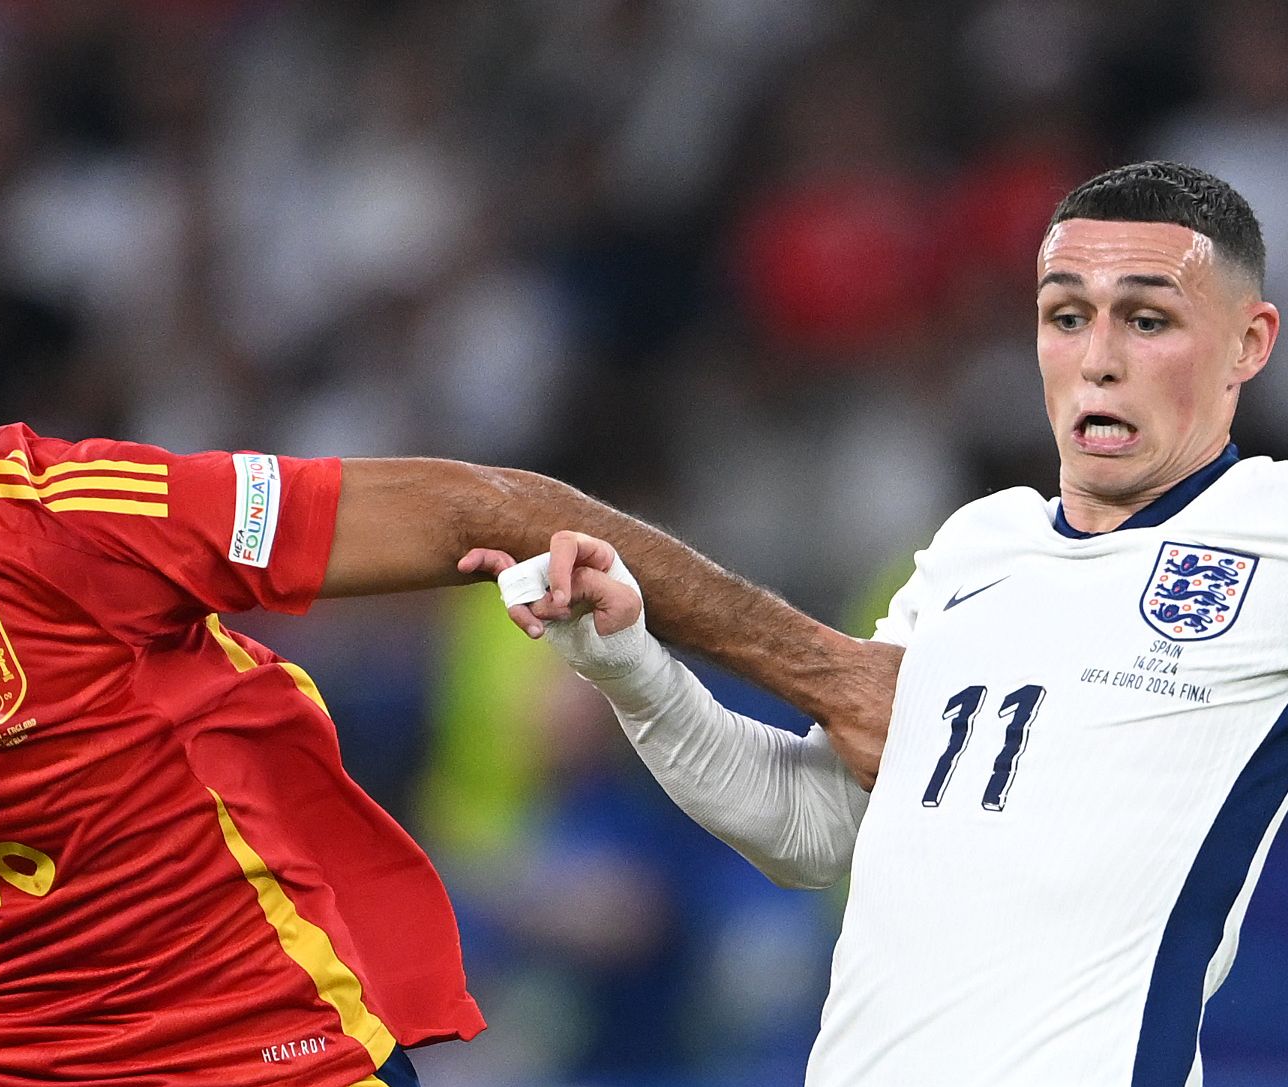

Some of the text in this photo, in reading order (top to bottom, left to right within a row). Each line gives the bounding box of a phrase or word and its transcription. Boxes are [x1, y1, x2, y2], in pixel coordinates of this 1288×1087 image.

[243, 456, 265, 561] FOUNDATION
[233, 529, 245, 558] UEFA
[1149, 639, 1184, 659] SPAIN
[1132, 655, 1178, 676] 14.07.24
[1080, 668, 1212, 704] UEFA EURO 2024 FINAL
[921, 684, 1047, 812] 11
